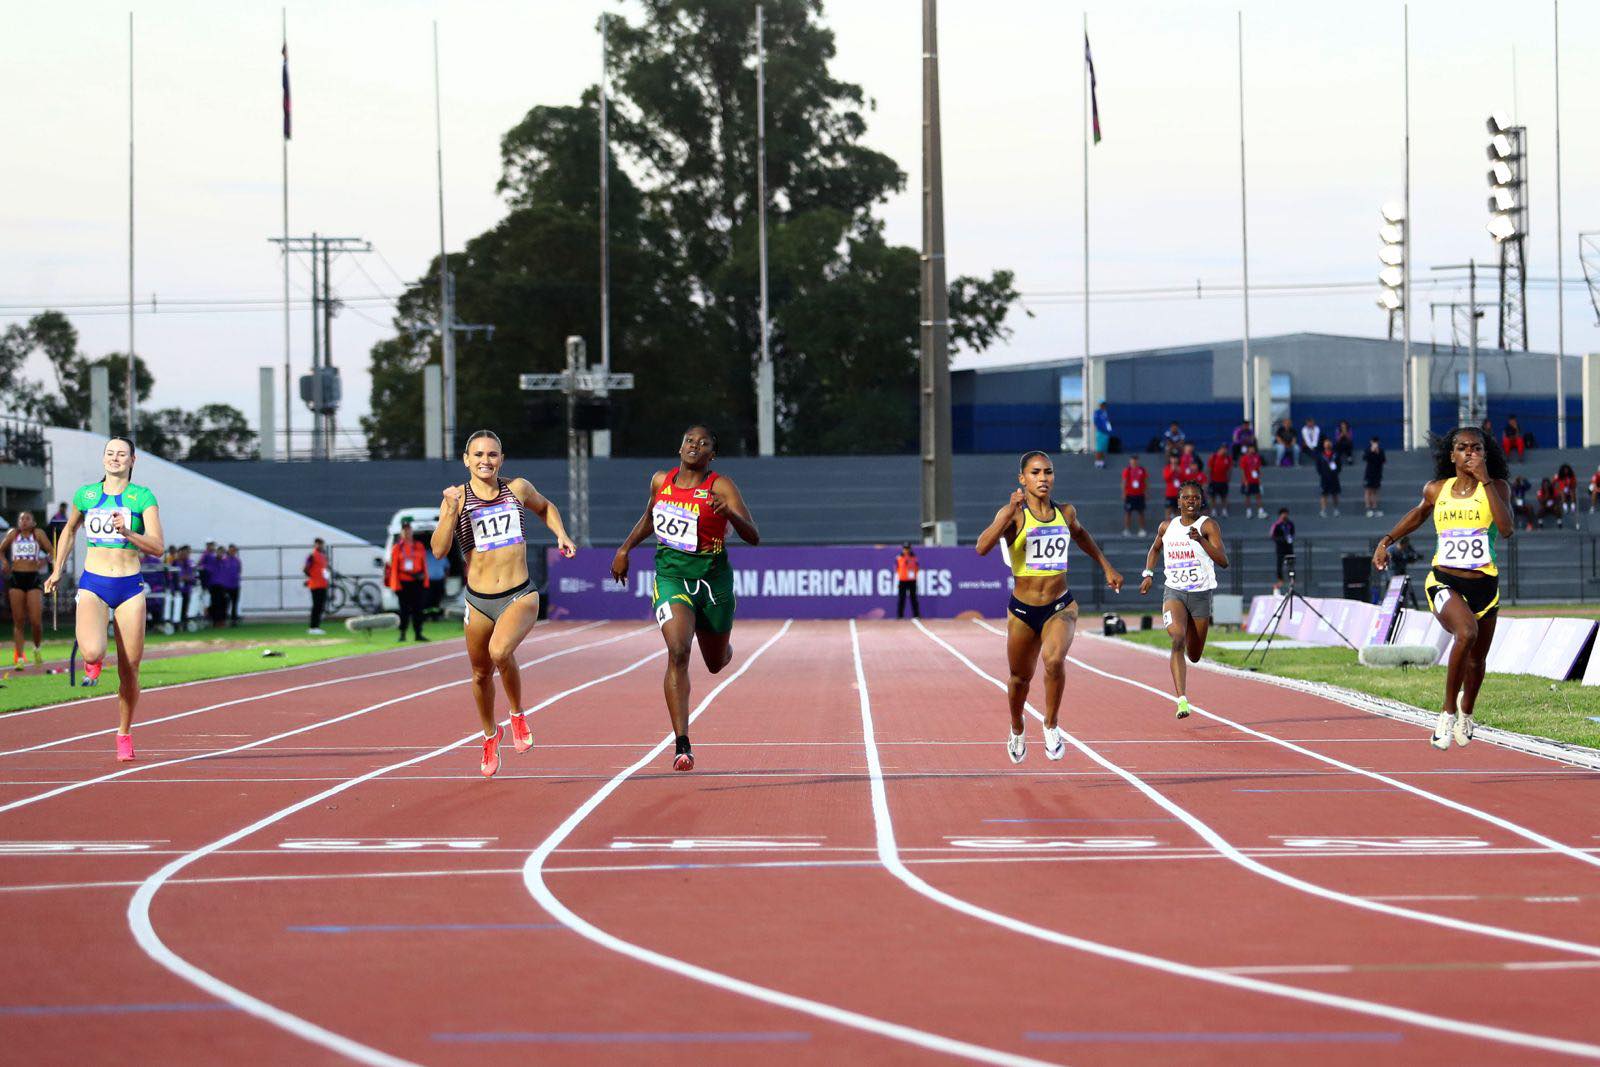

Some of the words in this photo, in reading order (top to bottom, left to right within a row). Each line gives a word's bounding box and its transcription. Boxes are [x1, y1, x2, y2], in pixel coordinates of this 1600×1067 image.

[90, 514, 119, 535] 06
[656, 514, 689, 537] 267
[1439, 510, 1480, 521] JAMAICA
[477, 514, 511, 538] 117
[1032, 537, 1066, 559] 169
[1168, 549, 1196, 560] PANAMA
[1444, 539, 1484, 559] 298
[733, 570, 758, 597] AN
[762, 569, 873, 597] AMERICAN
[1171, 568, 1198, 584] 365
[659, 607, 666, 622] 4
